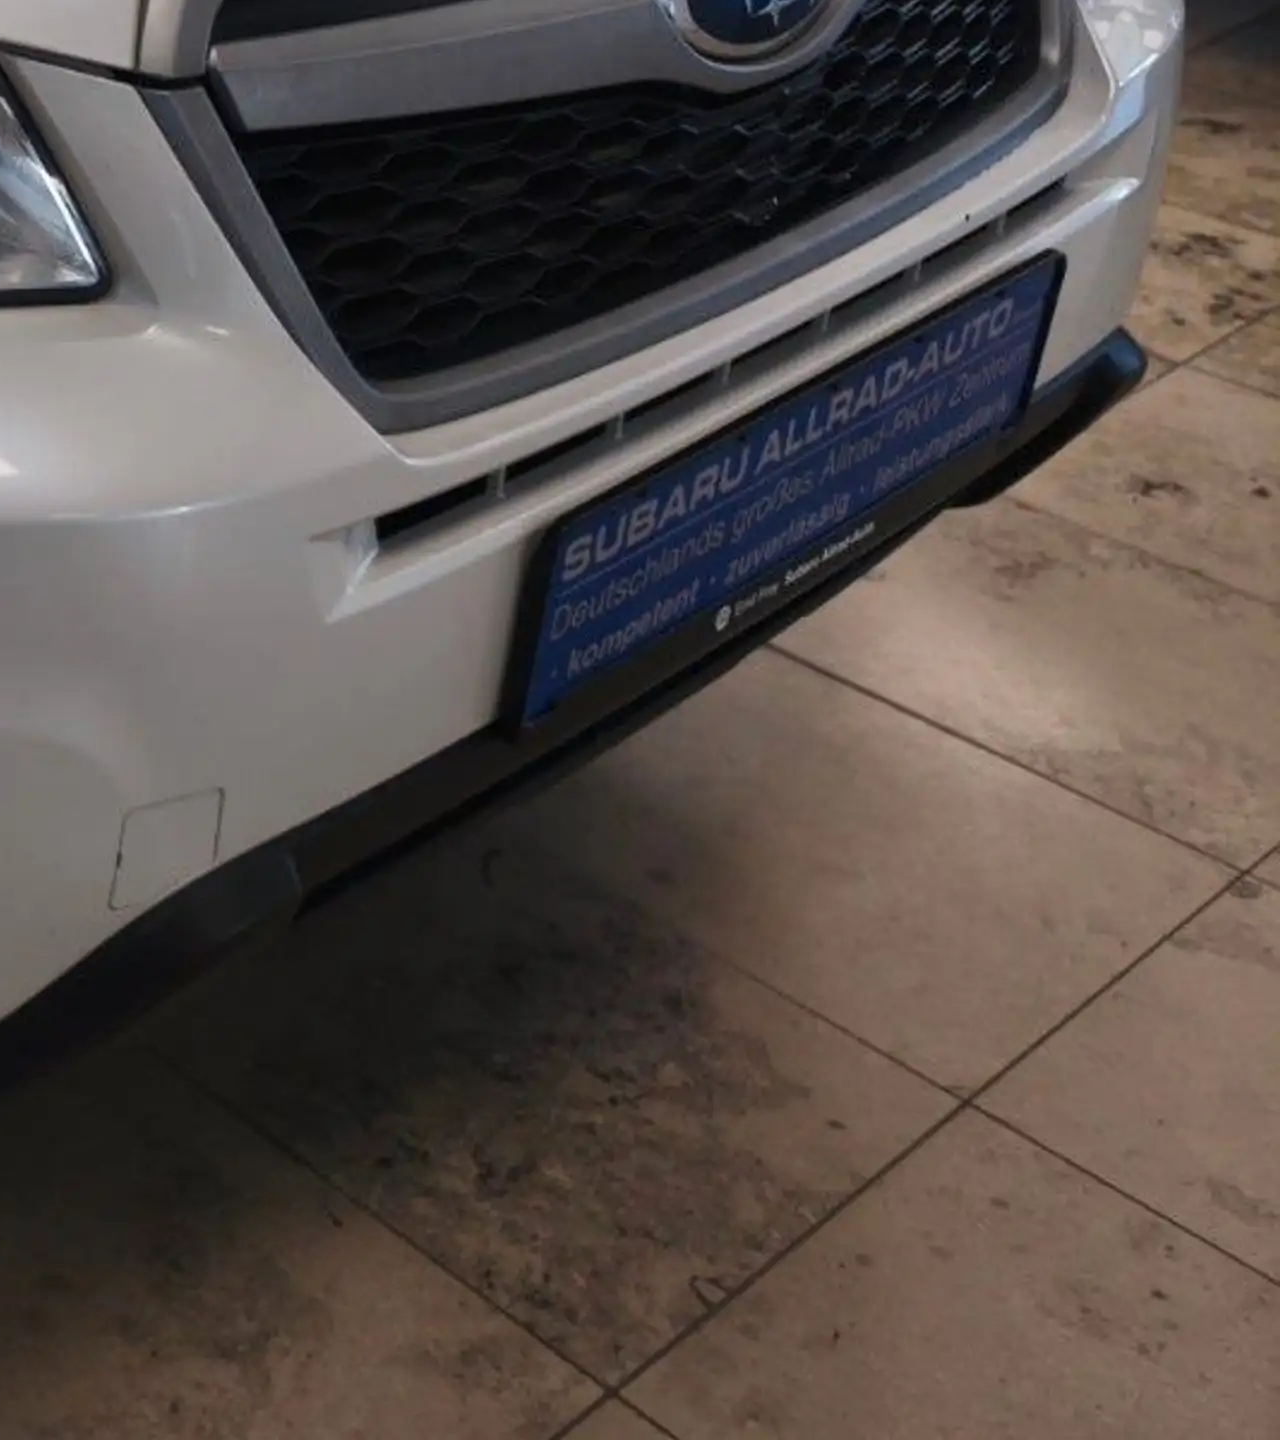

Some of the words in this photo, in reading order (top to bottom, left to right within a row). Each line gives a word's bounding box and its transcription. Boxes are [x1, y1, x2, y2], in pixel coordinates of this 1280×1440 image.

[561, 443, 752, 582] SUBARU
[754, 297, 1014, 476] ALLRAD-AUTO
[550, 520, 726, 641] Deutschlands
[566, 575, 701, 680] kompetent
